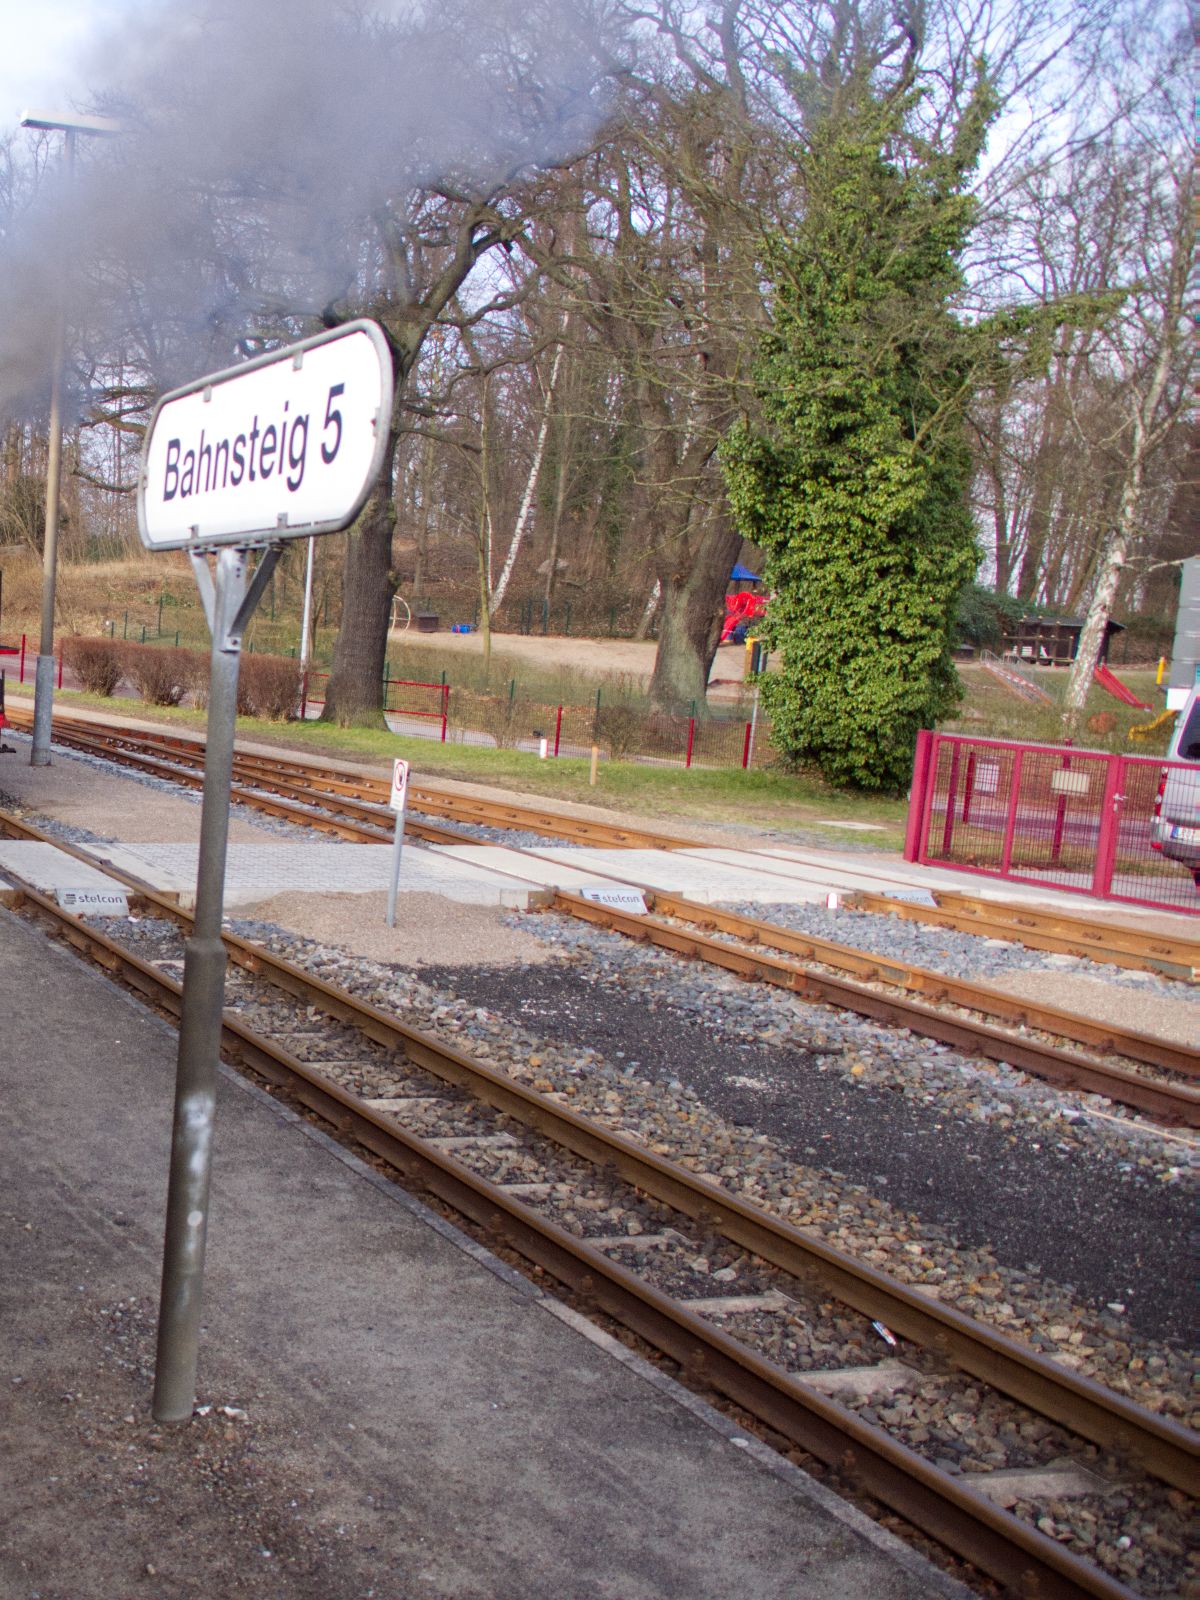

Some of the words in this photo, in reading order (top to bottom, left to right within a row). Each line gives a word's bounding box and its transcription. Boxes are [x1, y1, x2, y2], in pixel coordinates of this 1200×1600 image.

[162, 400, 311, 502] Bahnsteig
[321, 382, 345, 465] 5
[78, 894, 123, 904] stelcon
[602, 894, 641, 904] stelcon
